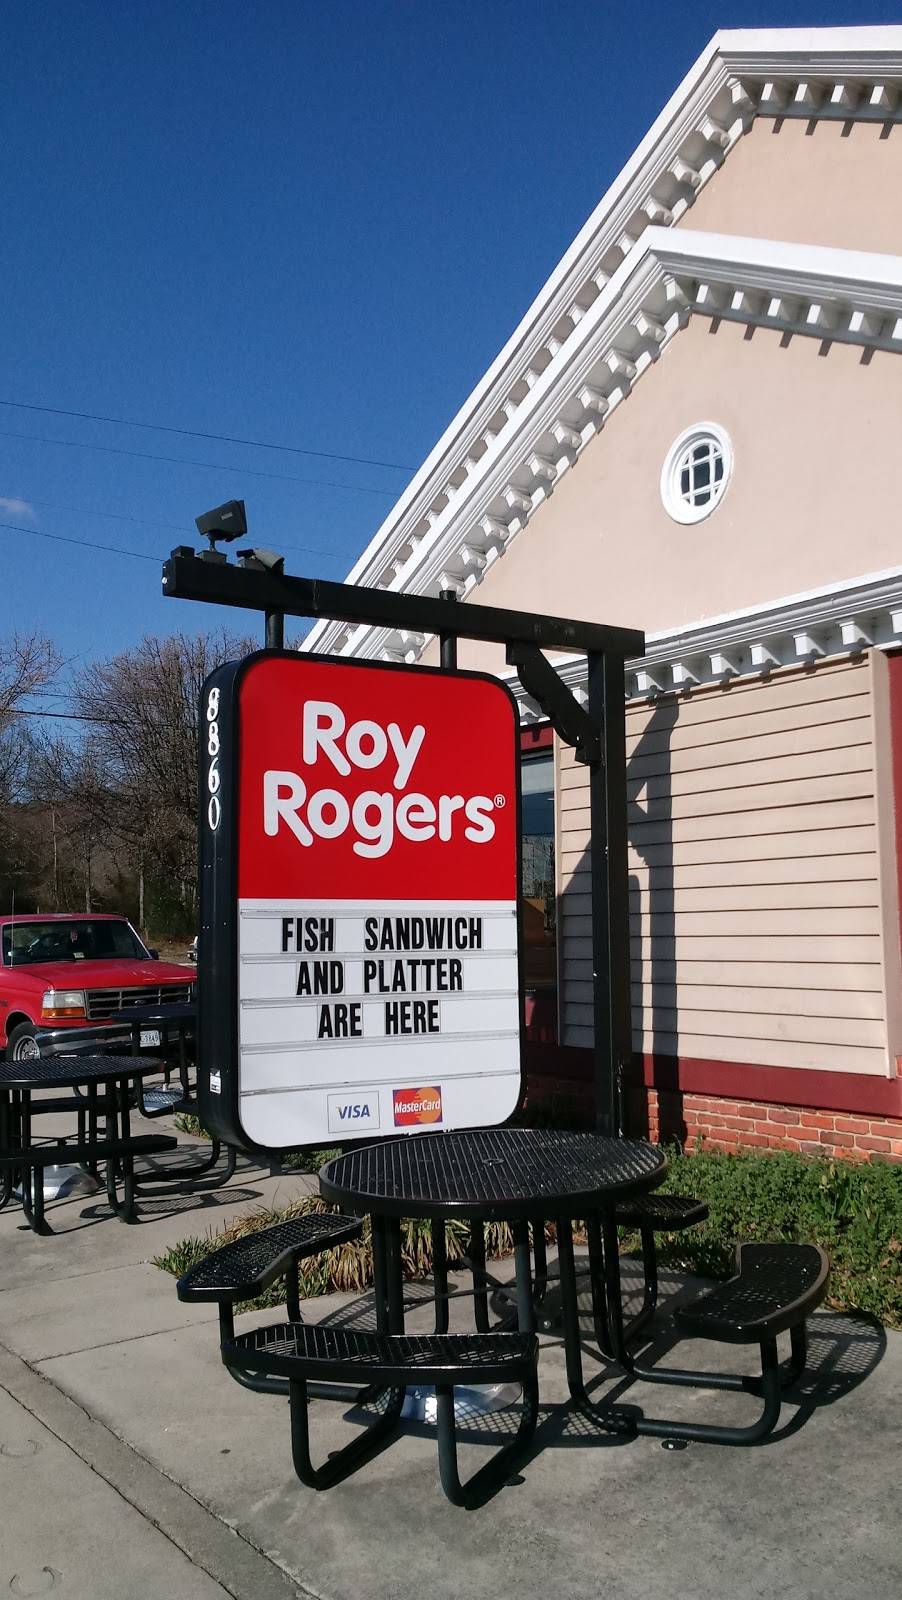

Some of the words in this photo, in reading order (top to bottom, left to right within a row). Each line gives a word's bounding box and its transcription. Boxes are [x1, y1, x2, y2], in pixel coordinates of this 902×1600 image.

[303, 700, 426, 790] Roy
[282, 917, 334, 952] FISH
[365, 917, 482, 951] SANDWICH
[296, 960, 344, 996] AND
[364, 958, 463, 993] PLATTER
[318, 1002, 363, 1039] ARE
[385, 1000, 440, 1035] HERE
[337, 1104, 371, 1119] VISA
[394, 1098, 441, 1114] MasterCard
